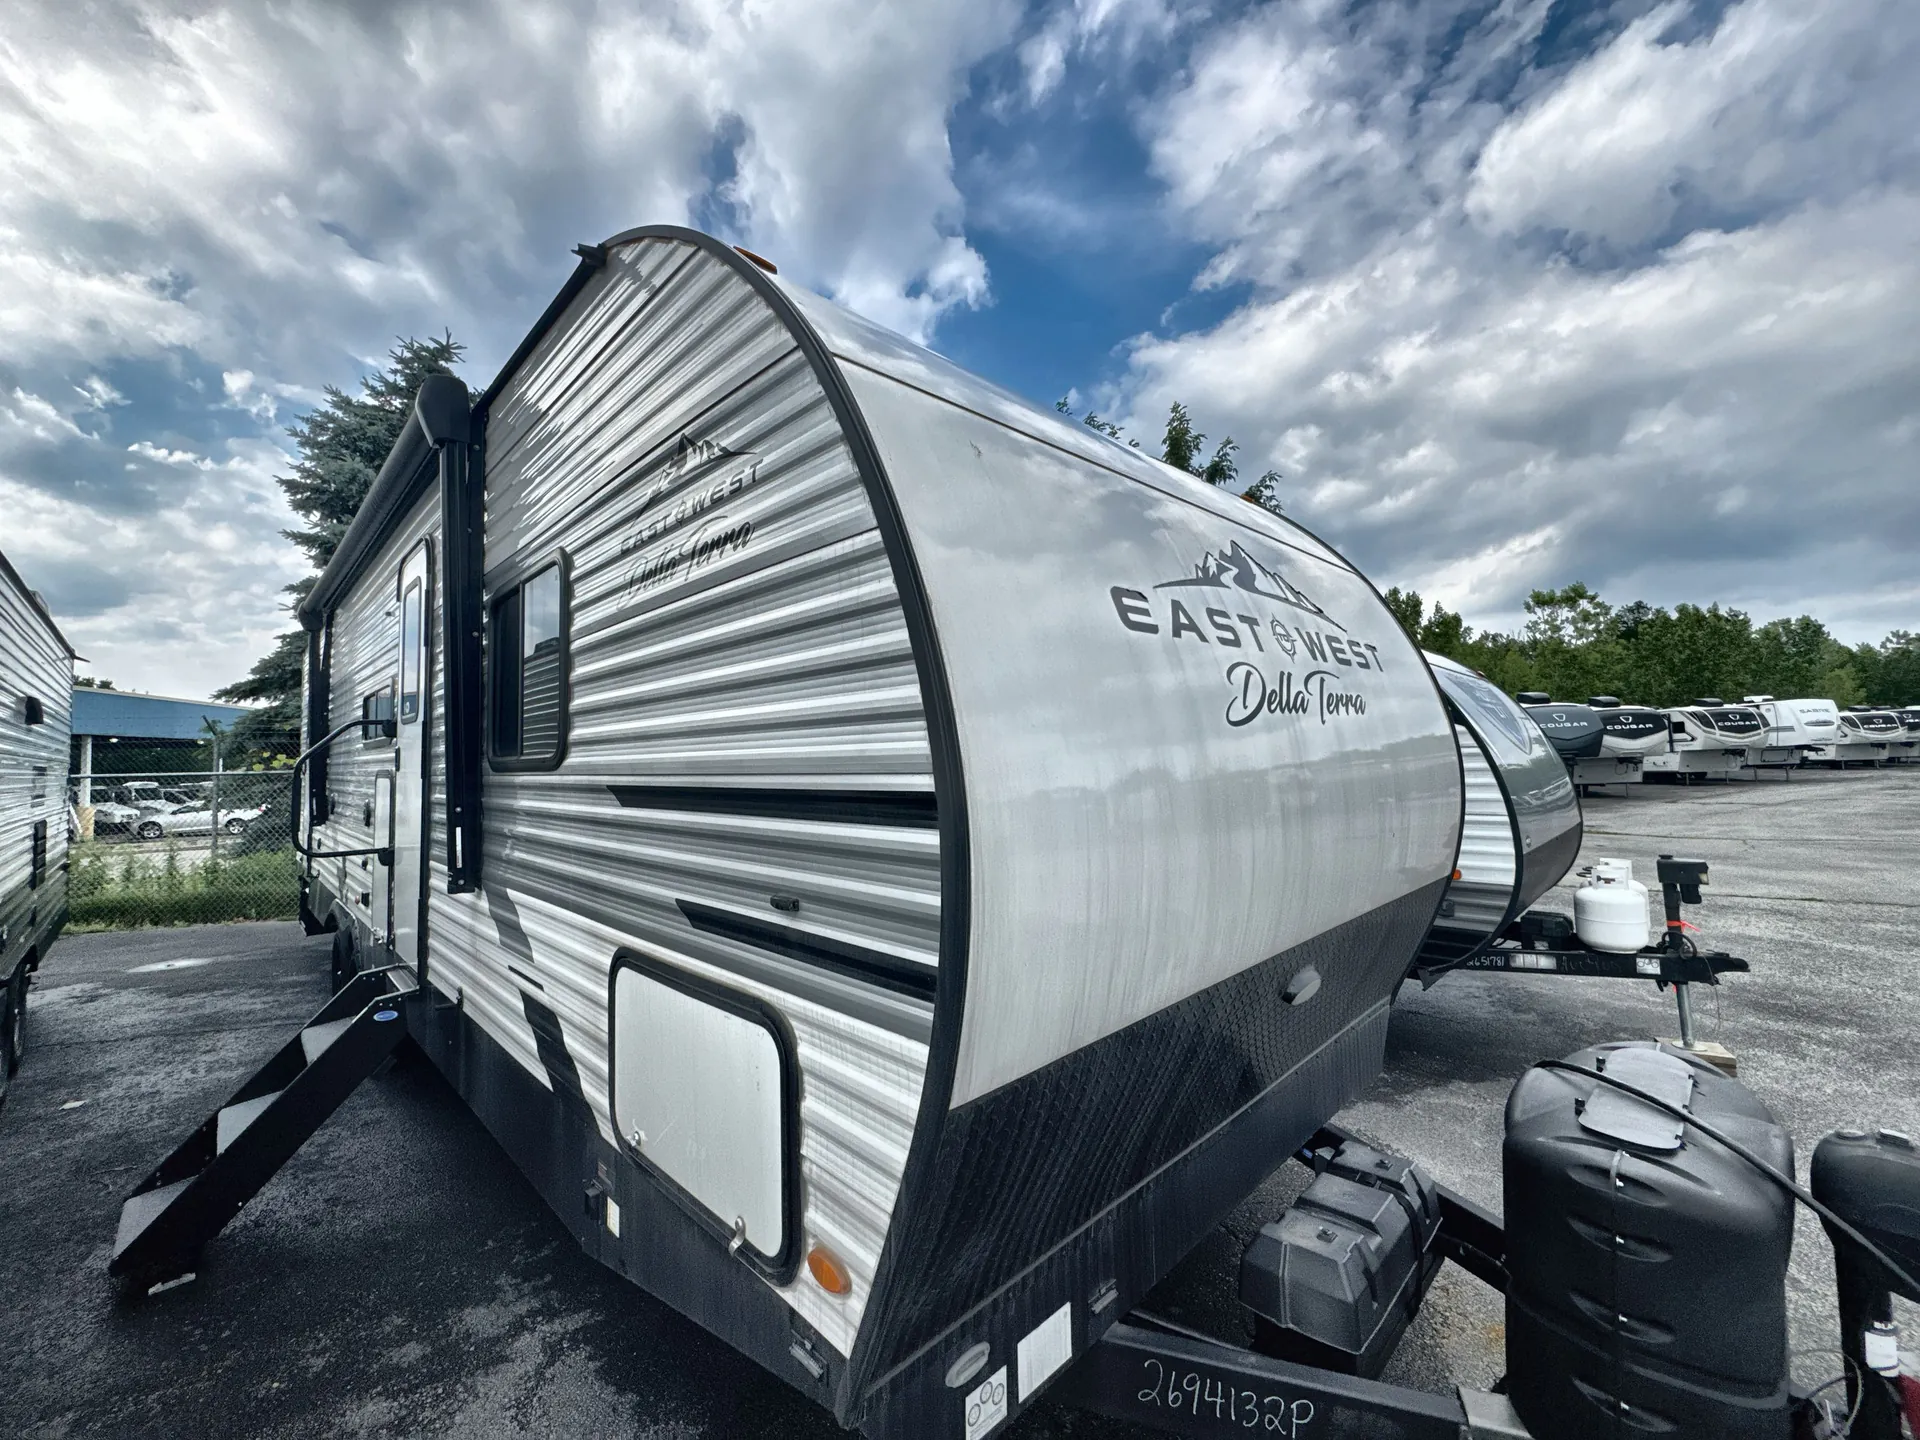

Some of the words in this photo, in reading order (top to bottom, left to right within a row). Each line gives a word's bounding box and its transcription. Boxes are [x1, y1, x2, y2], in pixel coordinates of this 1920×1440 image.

[691, 458, 764, 515] WEST
[1110, 585, 1265, 653] EAST
[1293, 626, 1384, 673] WEST
[1225, 661, 1309, 727] Della
[1303, 669, 1366, 725] Terra
[1539, 721, 1588, 729] COUGAR
[1137, 1359, 1314, 1439] 2694132P
